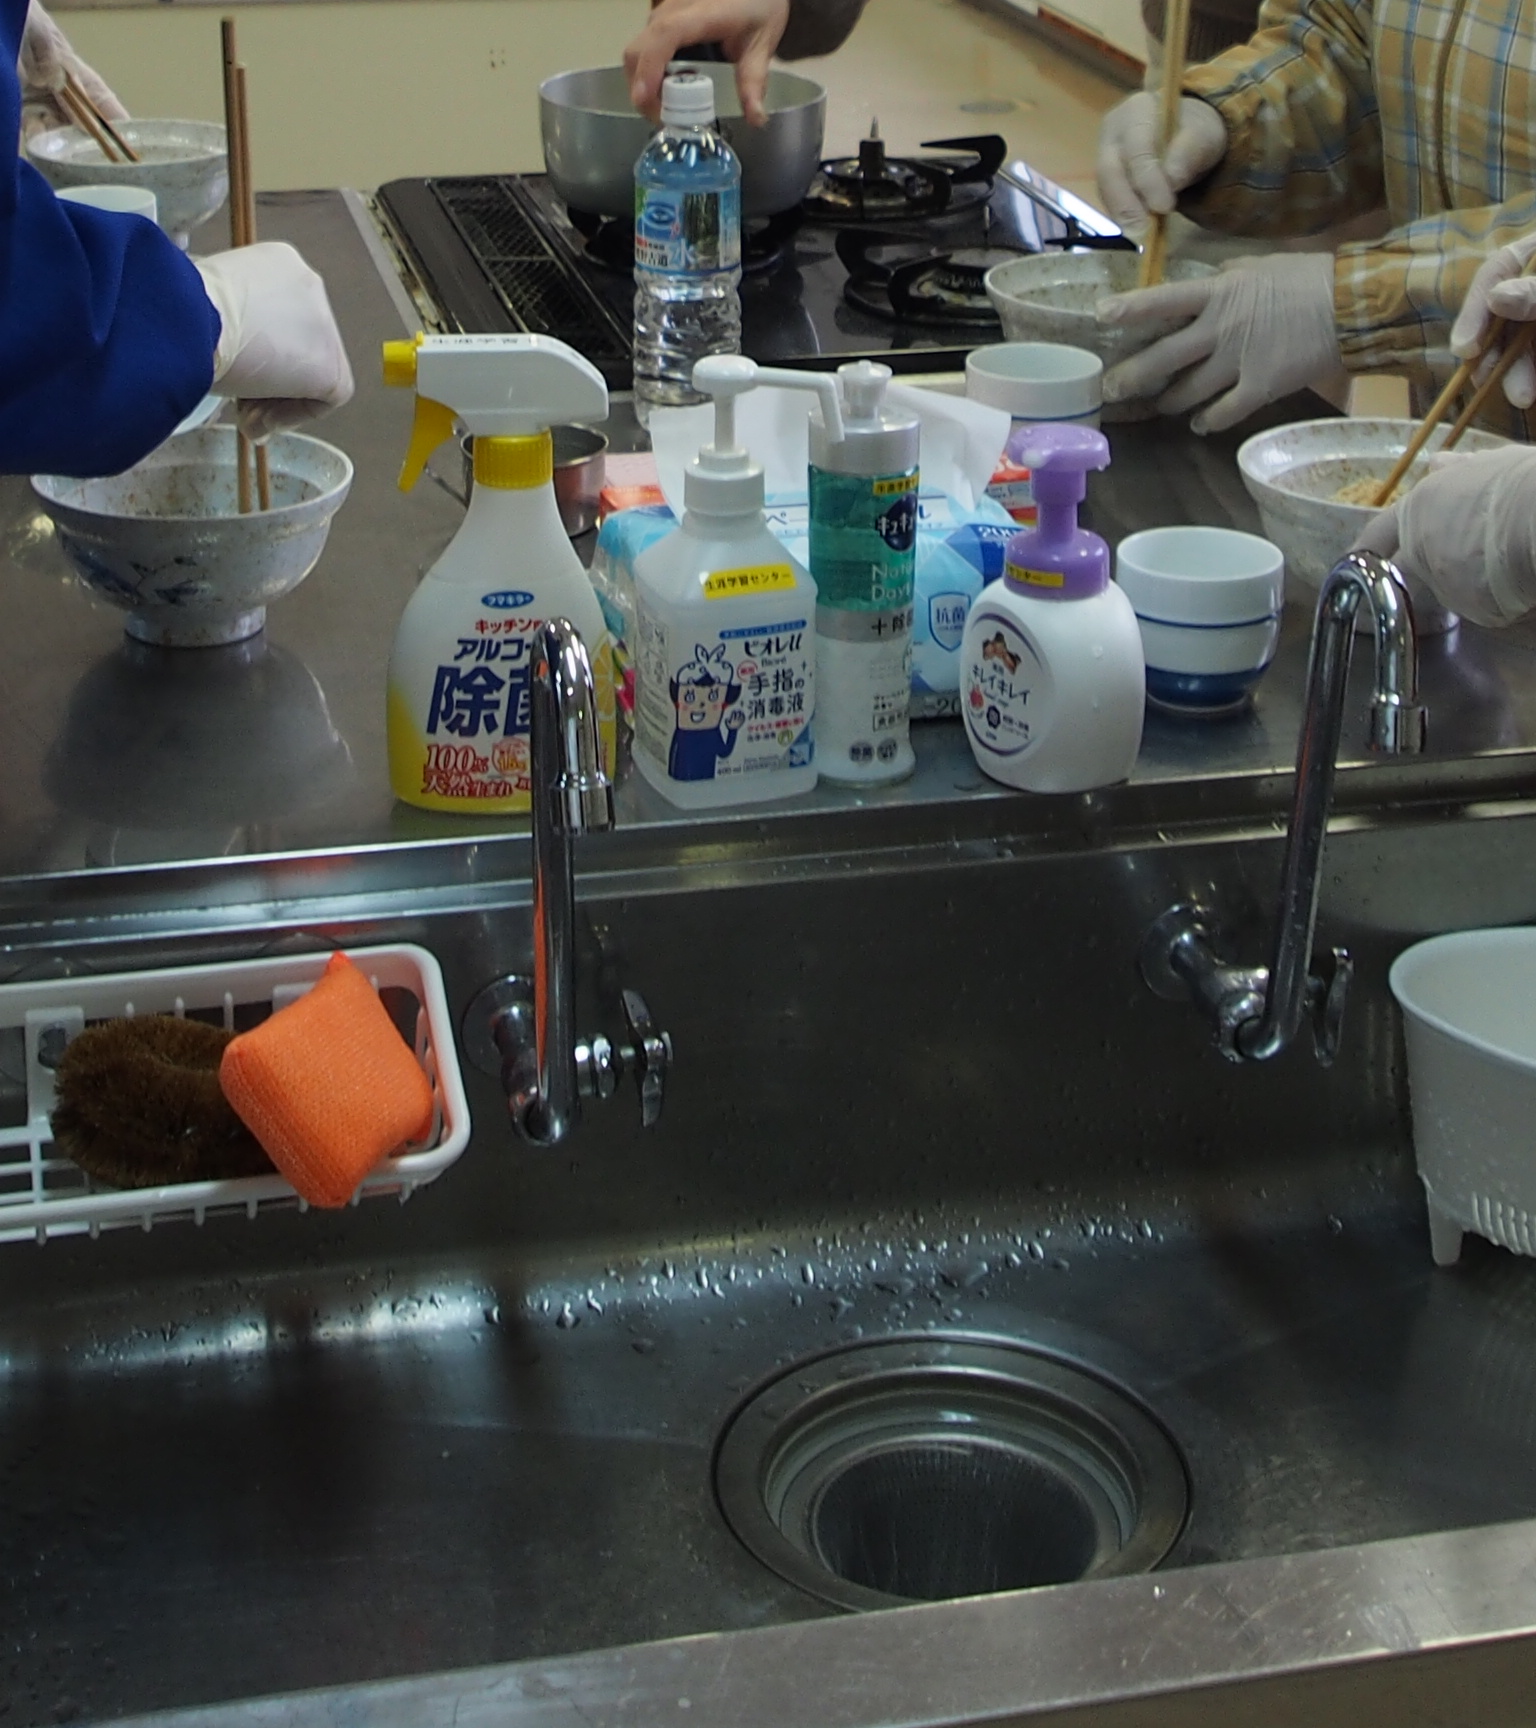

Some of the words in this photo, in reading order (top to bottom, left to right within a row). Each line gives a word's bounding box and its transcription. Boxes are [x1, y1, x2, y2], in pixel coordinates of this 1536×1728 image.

[748, 669, 805, 697] 手指の
[973, 664, 1031, 706] キレイキレイ
[748, 692, 805, 720] 消毒液
